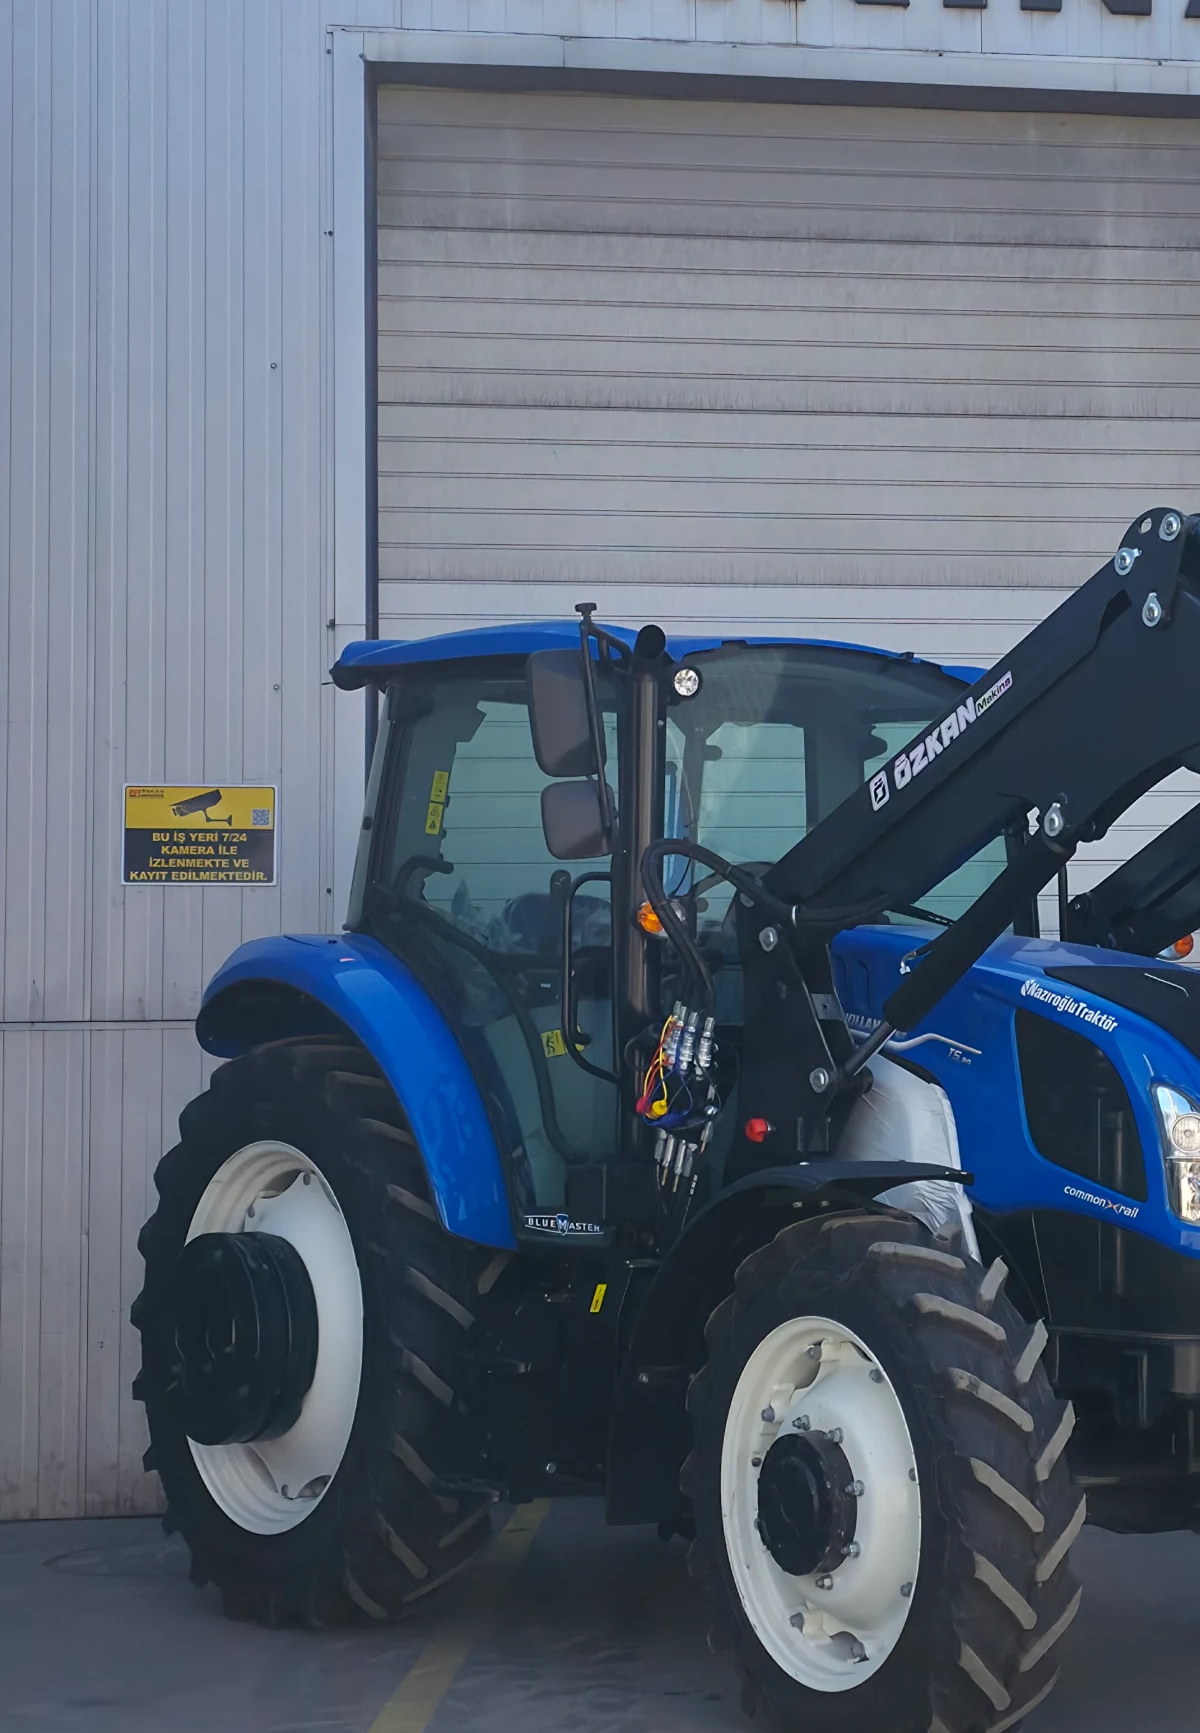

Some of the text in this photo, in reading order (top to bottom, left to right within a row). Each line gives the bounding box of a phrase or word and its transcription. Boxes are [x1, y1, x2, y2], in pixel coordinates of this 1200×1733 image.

[893, 696, 977, 790] ÖZKAN
[977, 676, 1012, 713] Makina
[152, 831, 248, 845] BU İŞ YERİ 7/24
[161, 843, 238, 856] KAMERA İLE
[149, 856, 250, 869] İZLENMEKTE VE
[130, 869, 268, 881] KAYIT EDİLMEKTEDİR.
[1064, 1185, 1140, 1219] common rail
